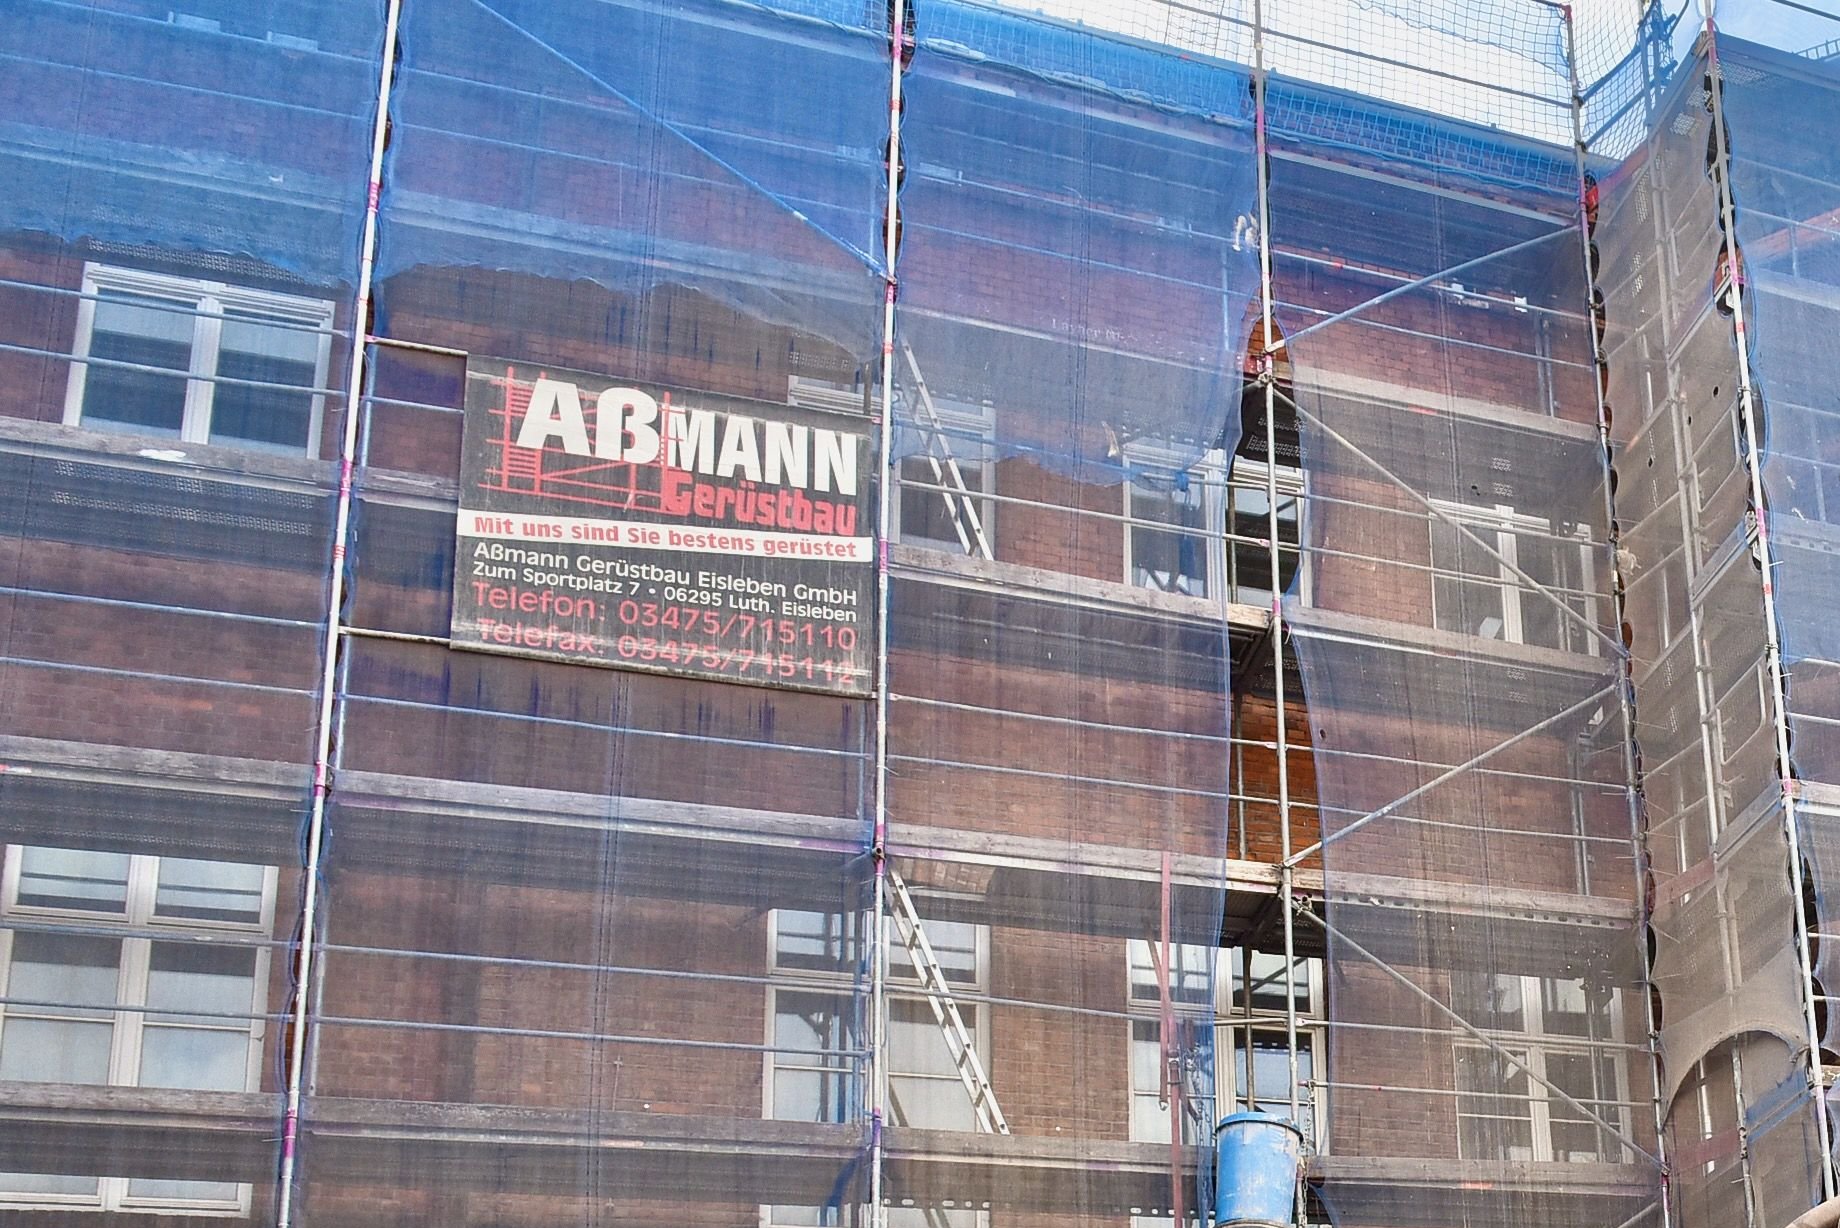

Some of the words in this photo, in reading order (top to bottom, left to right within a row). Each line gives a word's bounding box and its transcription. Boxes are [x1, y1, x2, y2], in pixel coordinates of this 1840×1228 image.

[517, 378, 857, 496] AßMANN
[661, 471, 856, 536] Gerüstbau
[474, 516, 514, 535] Mit
[522, 524, 563, 538] uns
[571, 525, 619, 542] sind
[627, 527, 661, 545] Sie
[668, 530, 755, 551] bestens
[763, 539, 857, 557] gerüstet
[473, 542, 569, 569] Aßmann
[576, 556, 690, 585] Gerüstbau
[699, 571, 787, 597] Eisleben
[793, 584, 857, 606] GmbH
[473, 561, 517, 580] Zum
[523, 568, 623, 594] Sportplatz
[629, 582, 641, 596] 7
[664, 586, 722, 606] 06295
[729, 595, 776, 613] Luth.
[782, 601, 857, 622] Eisleben
[472, 581, 606, 622] Telefon:
[619, 600, 857, 650] 03475/715110
[478, 617, 605, 657] Telefax:
[617, 635, 857, 684] 03475/715112
